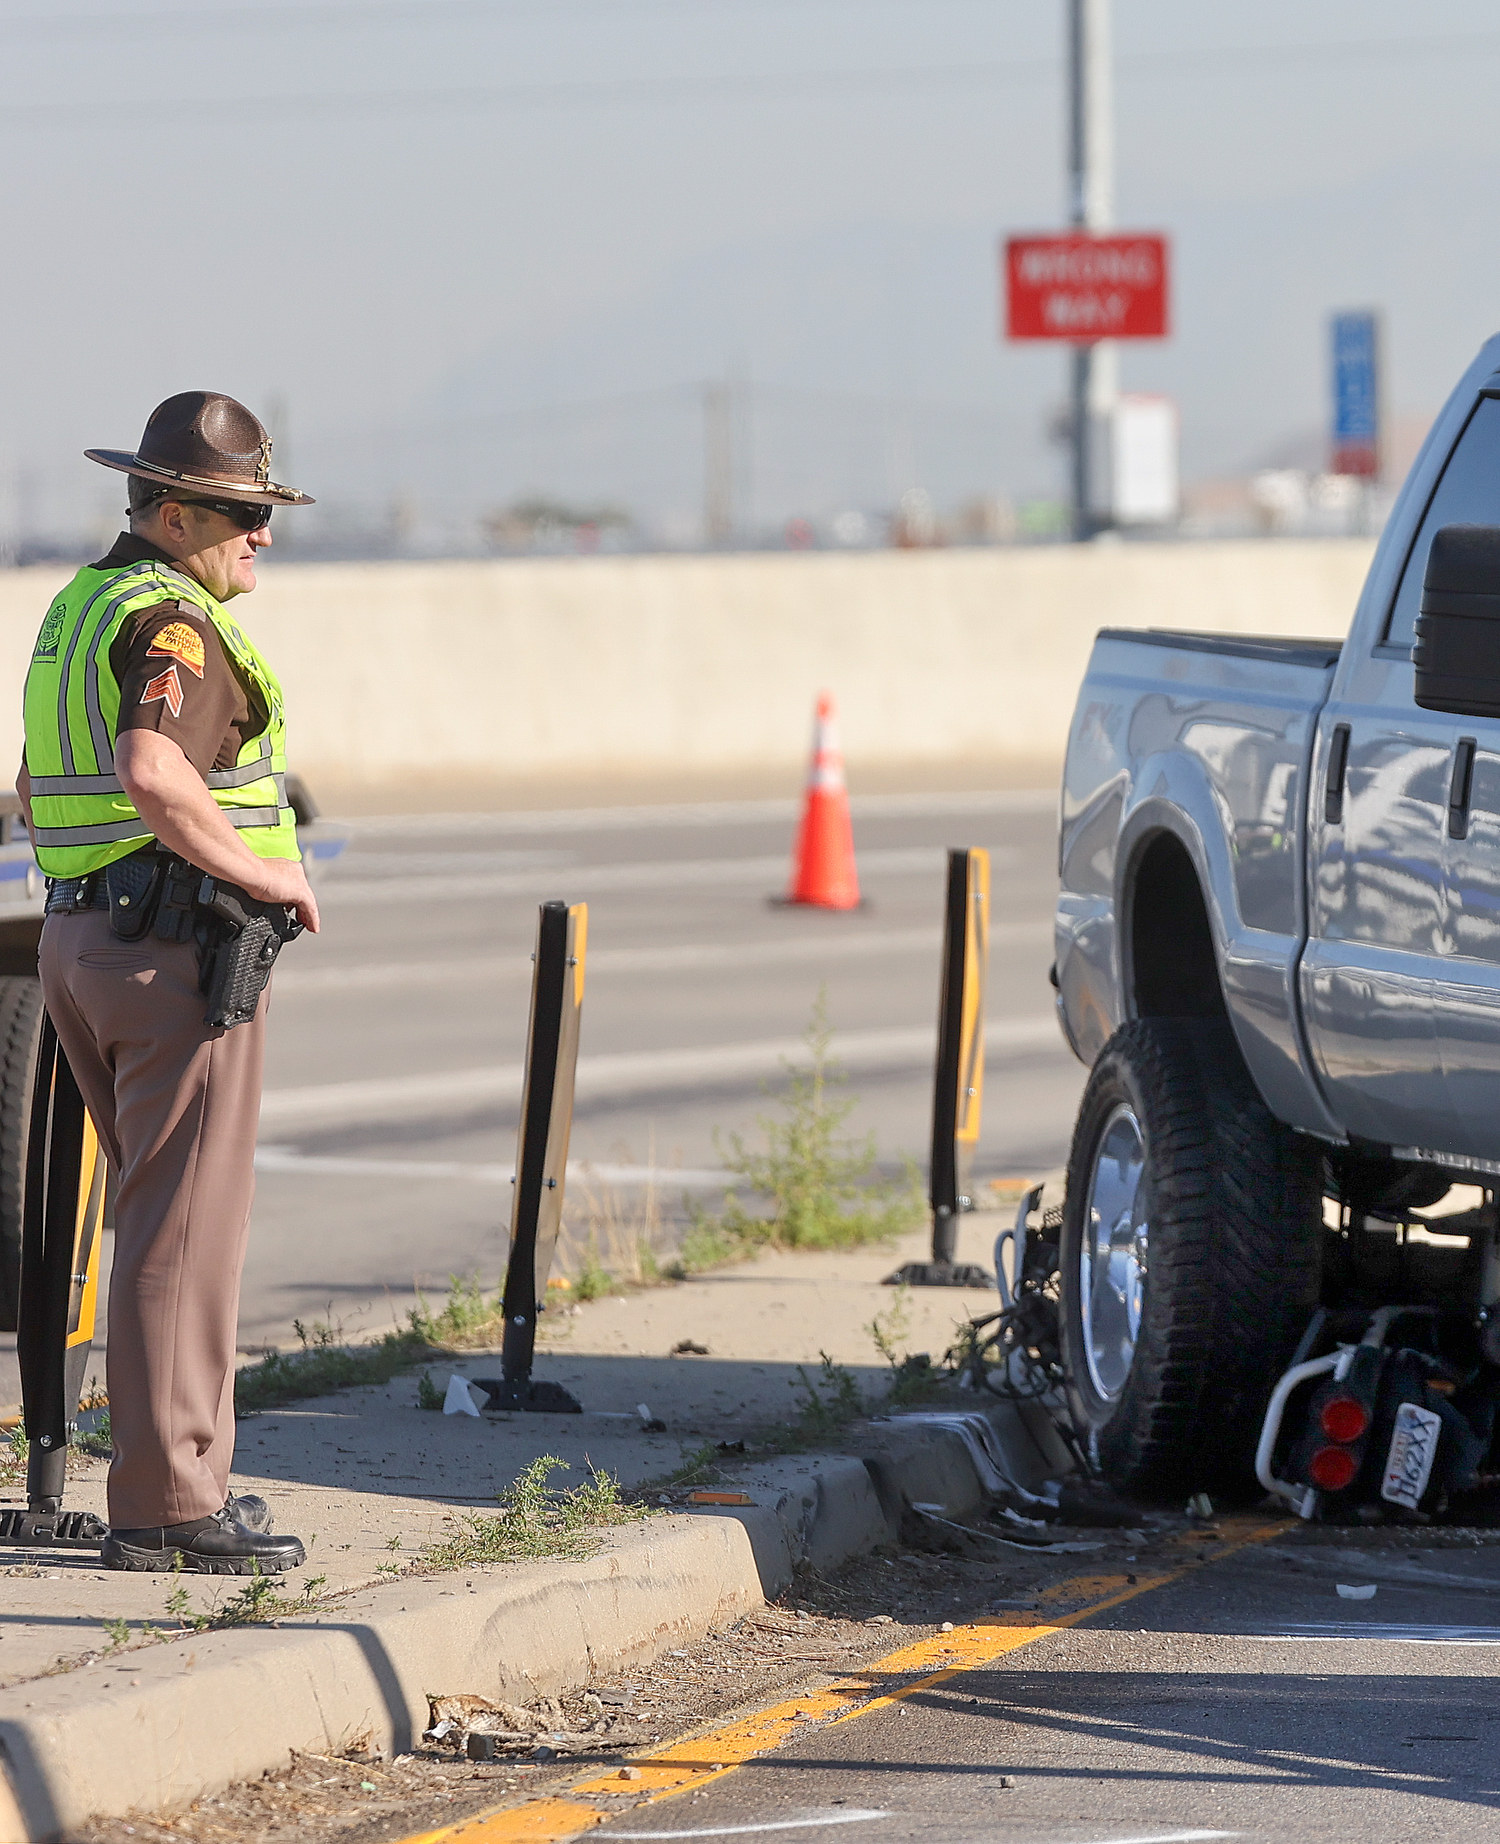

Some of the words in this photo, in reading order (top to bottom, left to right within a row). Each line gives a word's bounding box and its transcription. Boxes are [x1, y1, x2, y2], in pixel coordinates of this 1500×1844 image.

[163, 628, 203, 650] HIGHWAY
[174, 625, 198, 639] UTAH
[165, 637, 197, 655] PATROL
